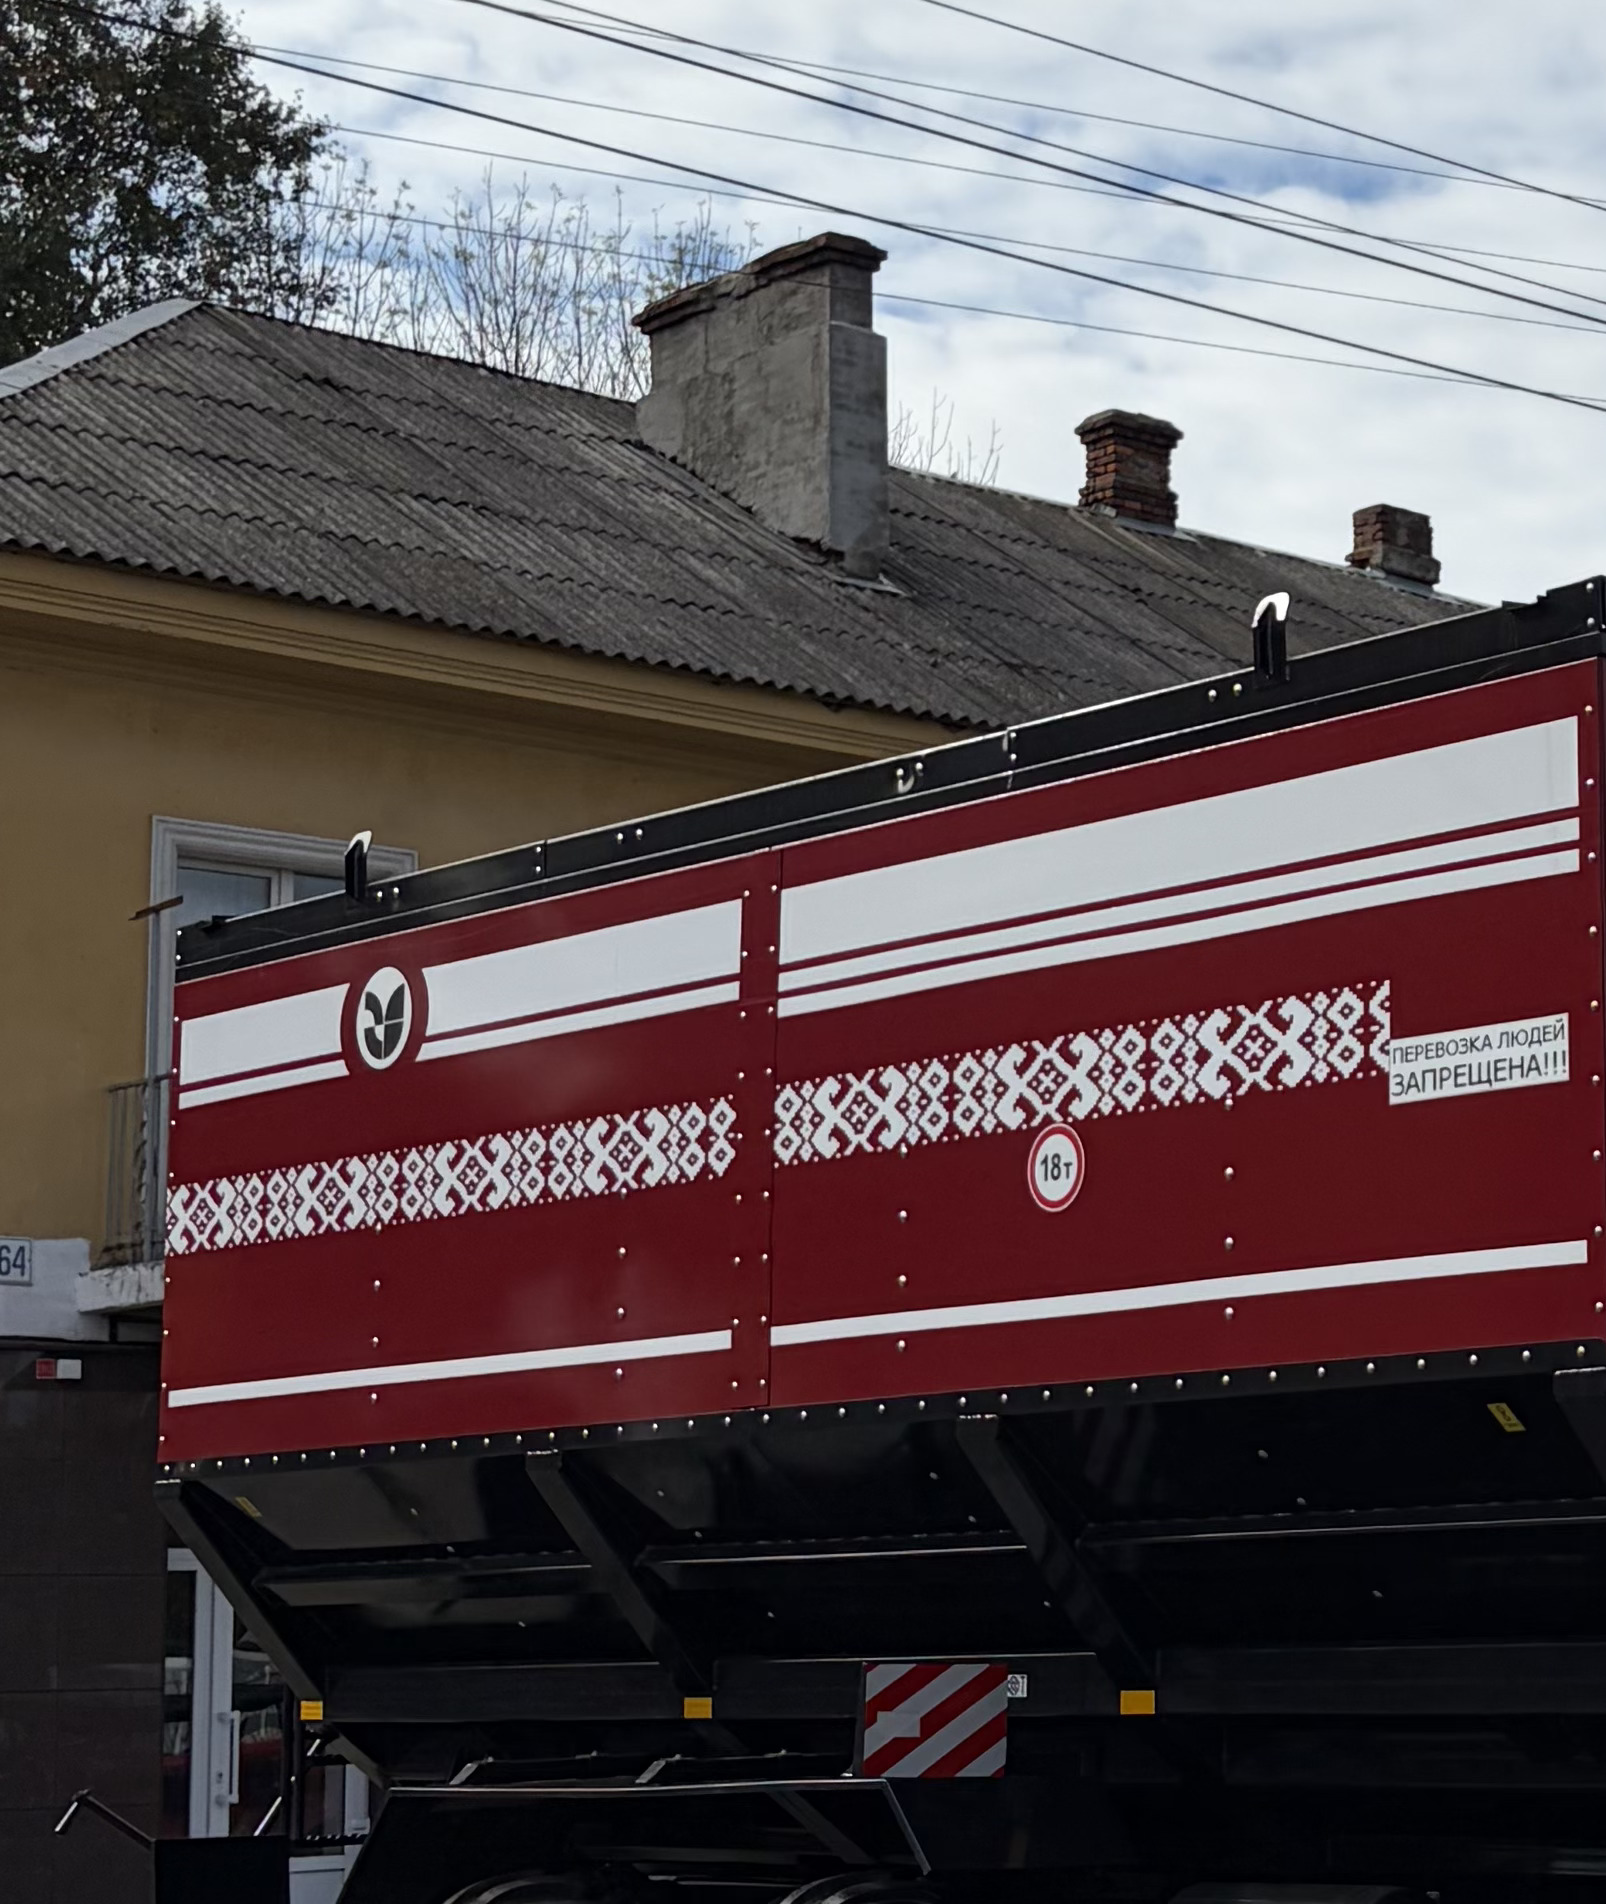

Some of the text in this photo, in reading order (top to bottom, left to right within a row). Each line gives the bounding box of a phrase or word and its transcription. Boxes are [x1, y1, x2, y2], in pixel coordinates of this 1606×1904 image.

[1392, 1018, 1566, 1065] ПЕРЕВОЗКА ЛЮДЕЙ
[1391, 1049, 1567, 1097] ЗАПРЕЩЕНА!!!
[0, 1245, 25, 1277] 64
